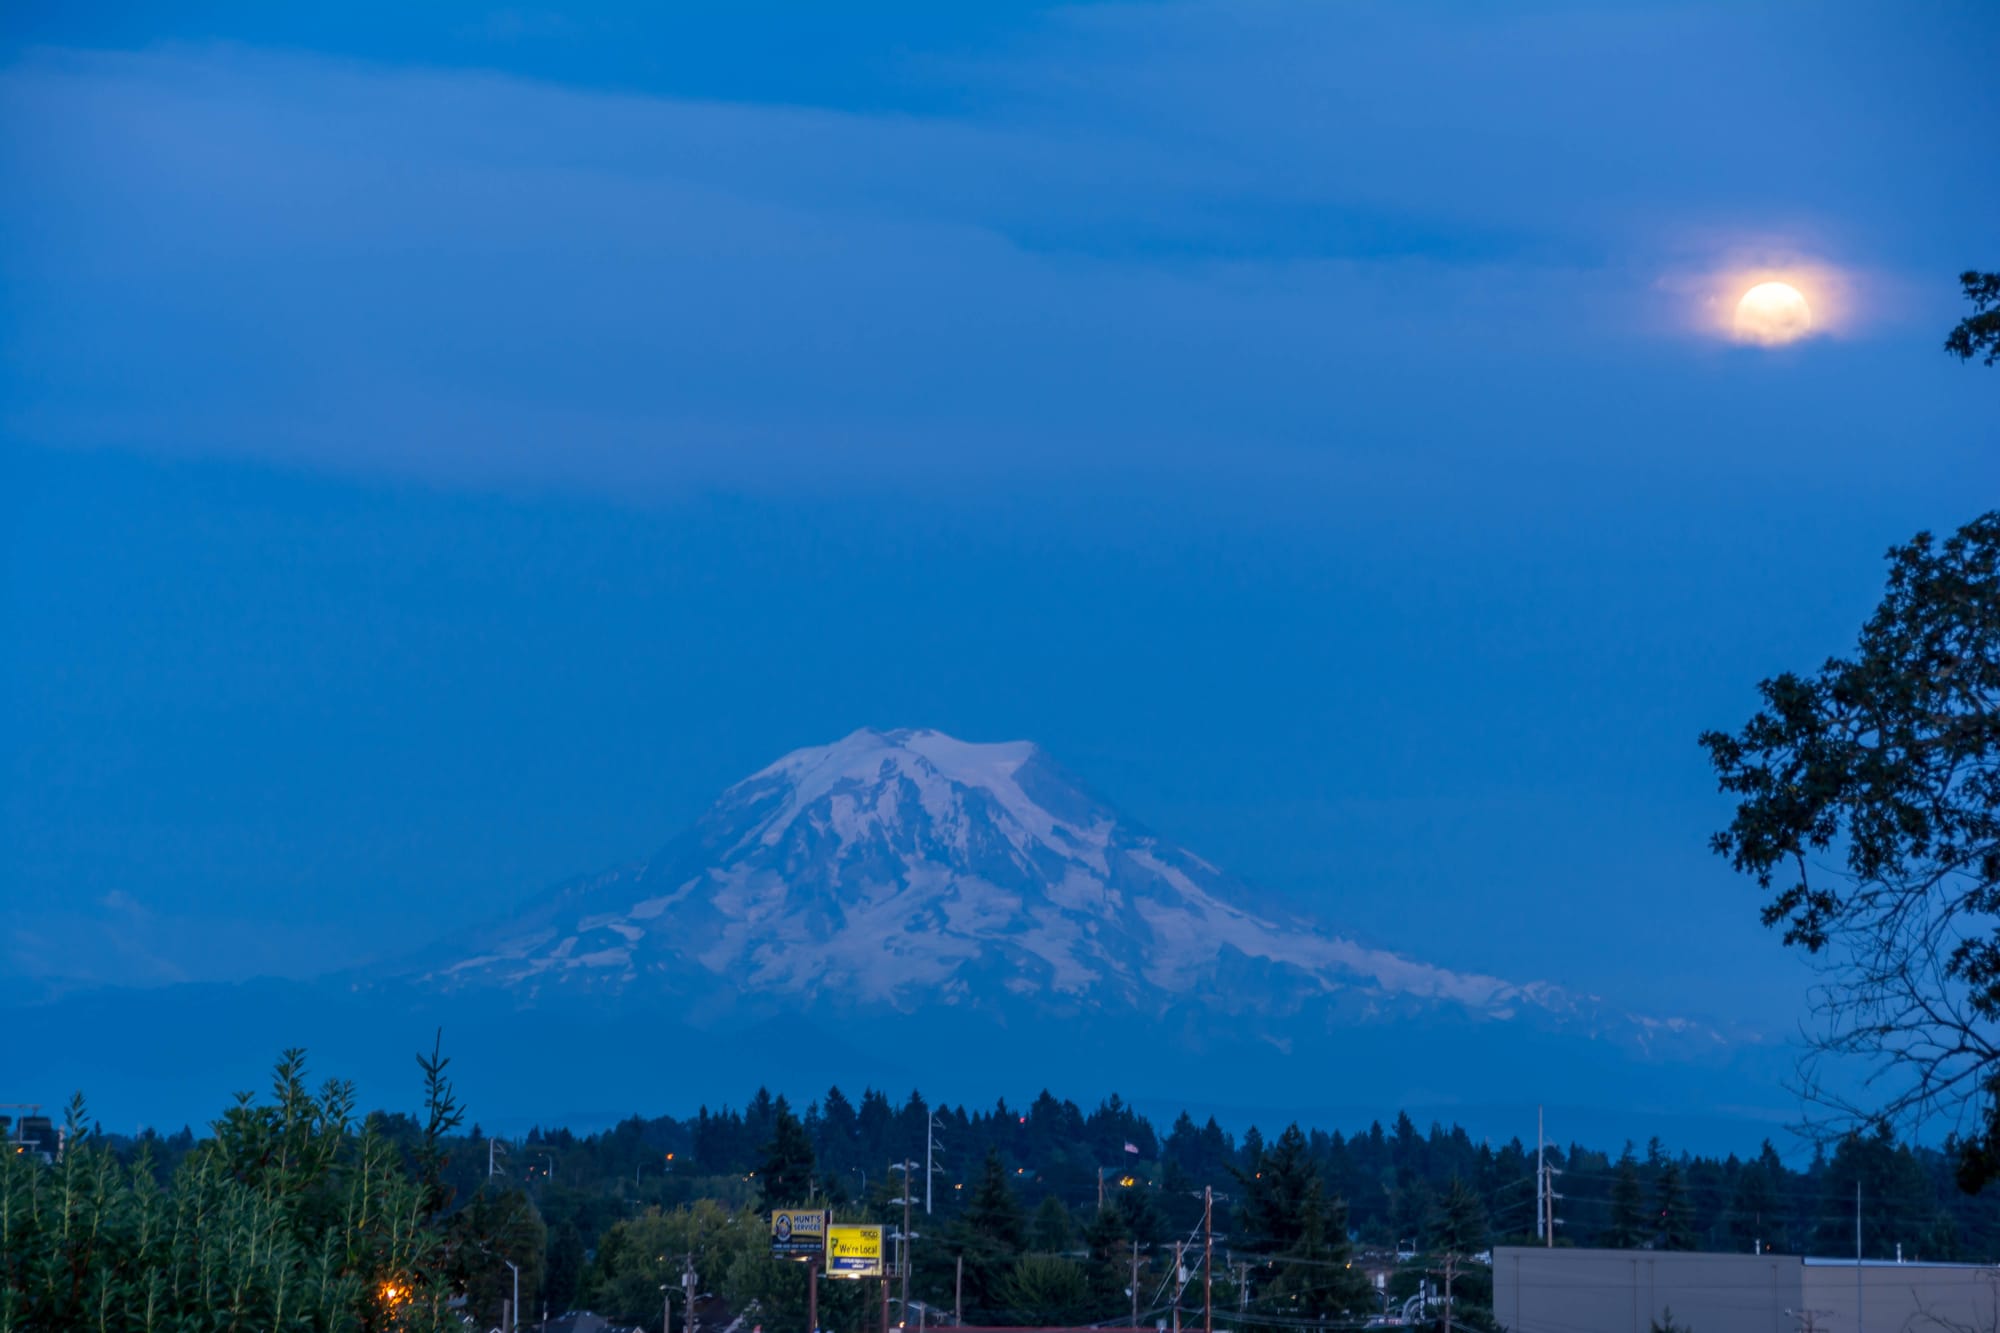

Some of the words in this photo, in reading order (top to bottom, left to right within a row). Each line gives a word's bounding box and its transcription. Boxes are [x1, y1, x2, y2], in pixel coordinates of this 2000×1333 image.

[793, 1215, 821, 1223] HUNT'S
[839, 1244, 859, 1254] We're
[860, 1244, 878, 1254] Local
